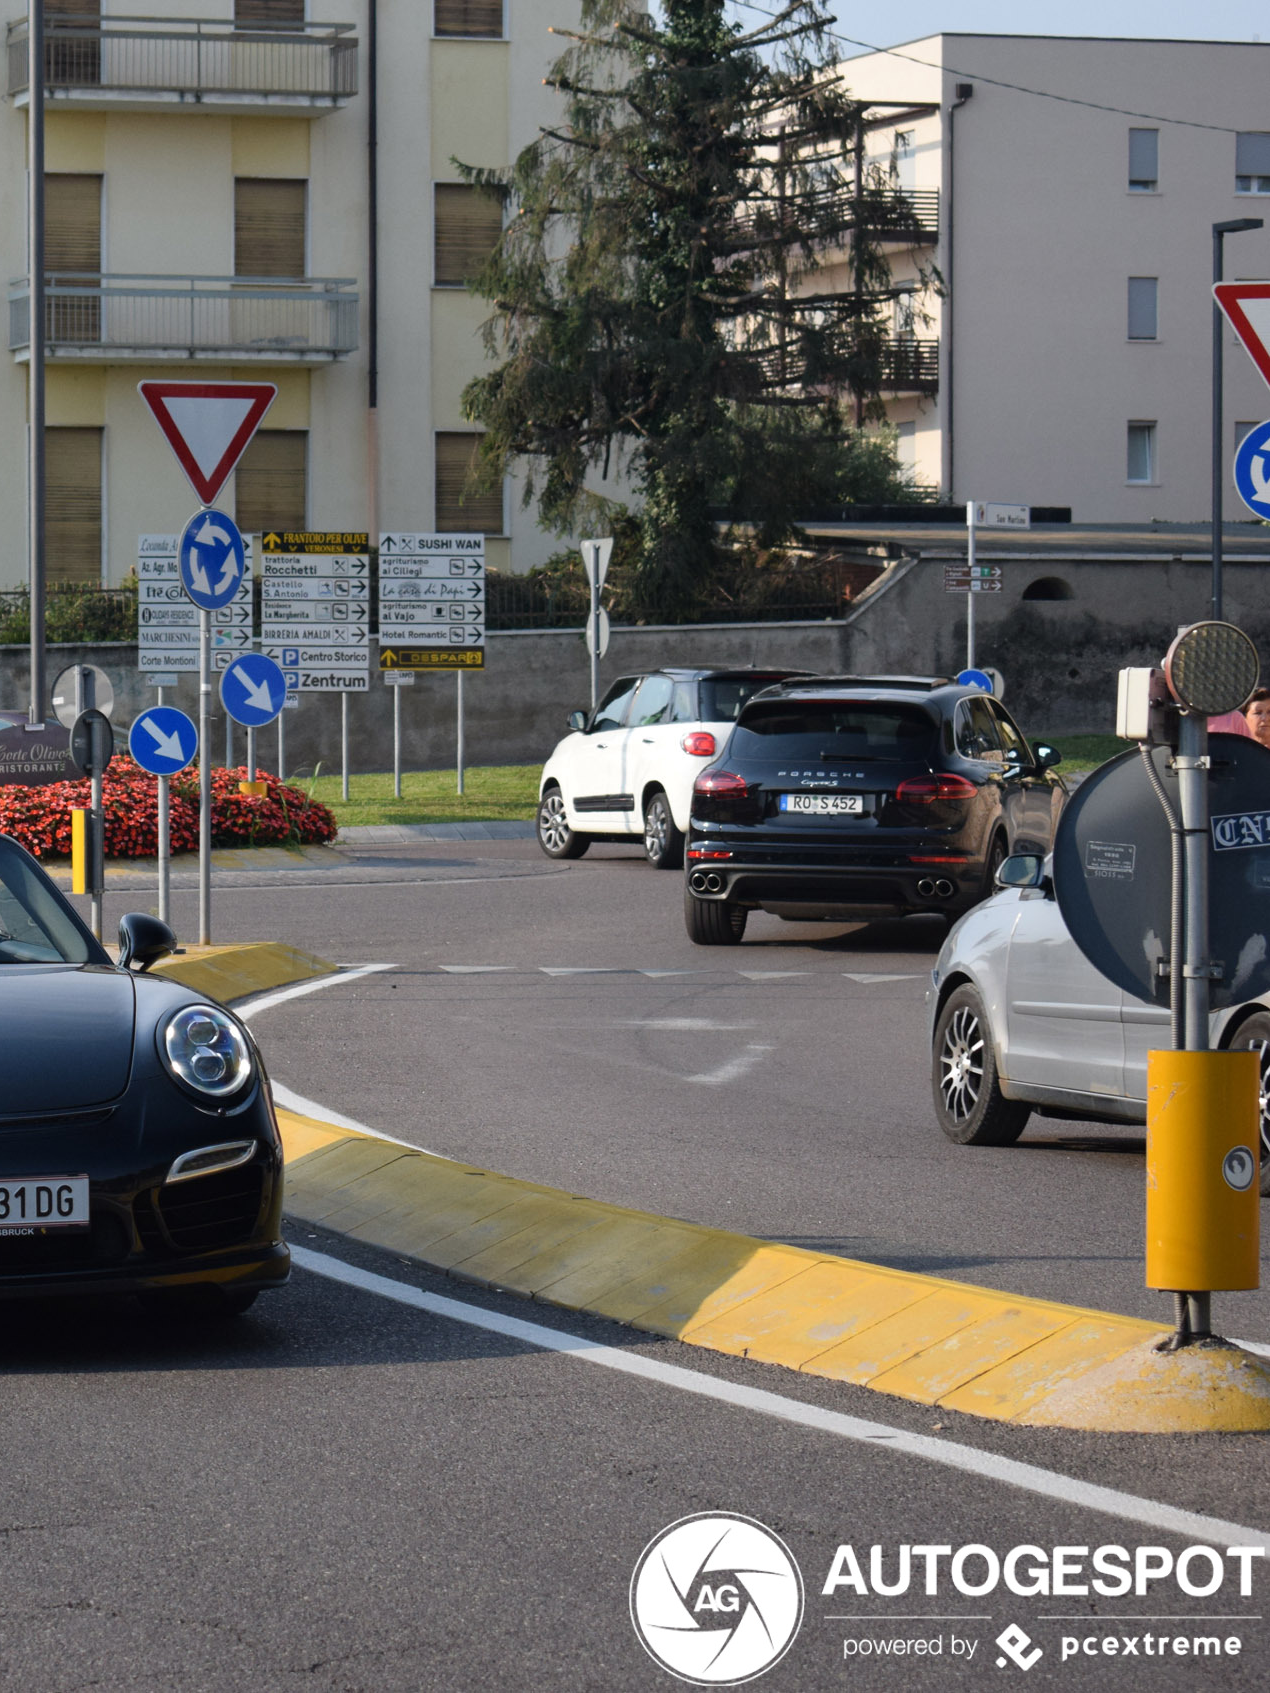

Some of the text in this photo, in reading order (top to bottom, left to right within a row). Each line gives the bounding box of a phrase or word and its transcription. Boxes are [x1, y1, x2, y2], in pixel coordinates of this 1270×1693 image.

[283, 532, 367, 545] FRANTOIO PER OLIVE
[304, 544, 344, 553] VERONESI
[418, 539, 482, 550] SUSHI WAN
[264, 556, 300, 564] trattoria
[382, 558, 429, 566] agriturismo
[152, 561, 165, 576] Agr.
[264, 565, 317, 574] Rocchetti
[382, 567, 422, 577] ai Ciliegi
[263, 579, 303, 589] Castello
[264, 589, 309, 598] S. Antonio
[382, 583, 465, 599] La casa di Papi
[382, 603, 427, 611] agriturismo
[265, 611, 310, 620] La Margherita
[382, 612, 415, 622] al Vajo
[141, 632, 191, 643] MARCHESINI
[302, 630, 331, 640] AMALDI
[382, 631, 448, 640] Hotel Romantic
[141, 655, 196, 666] Corte Montioni
[285, 650, 367, 665] P Centro Storico
[410, 653, 466, 663] DESPAR
[301, 673, 366, 688] Zentrum
[793, 795, 857, 811] RO S 452
[36, 1184, 74, 1218] DG
